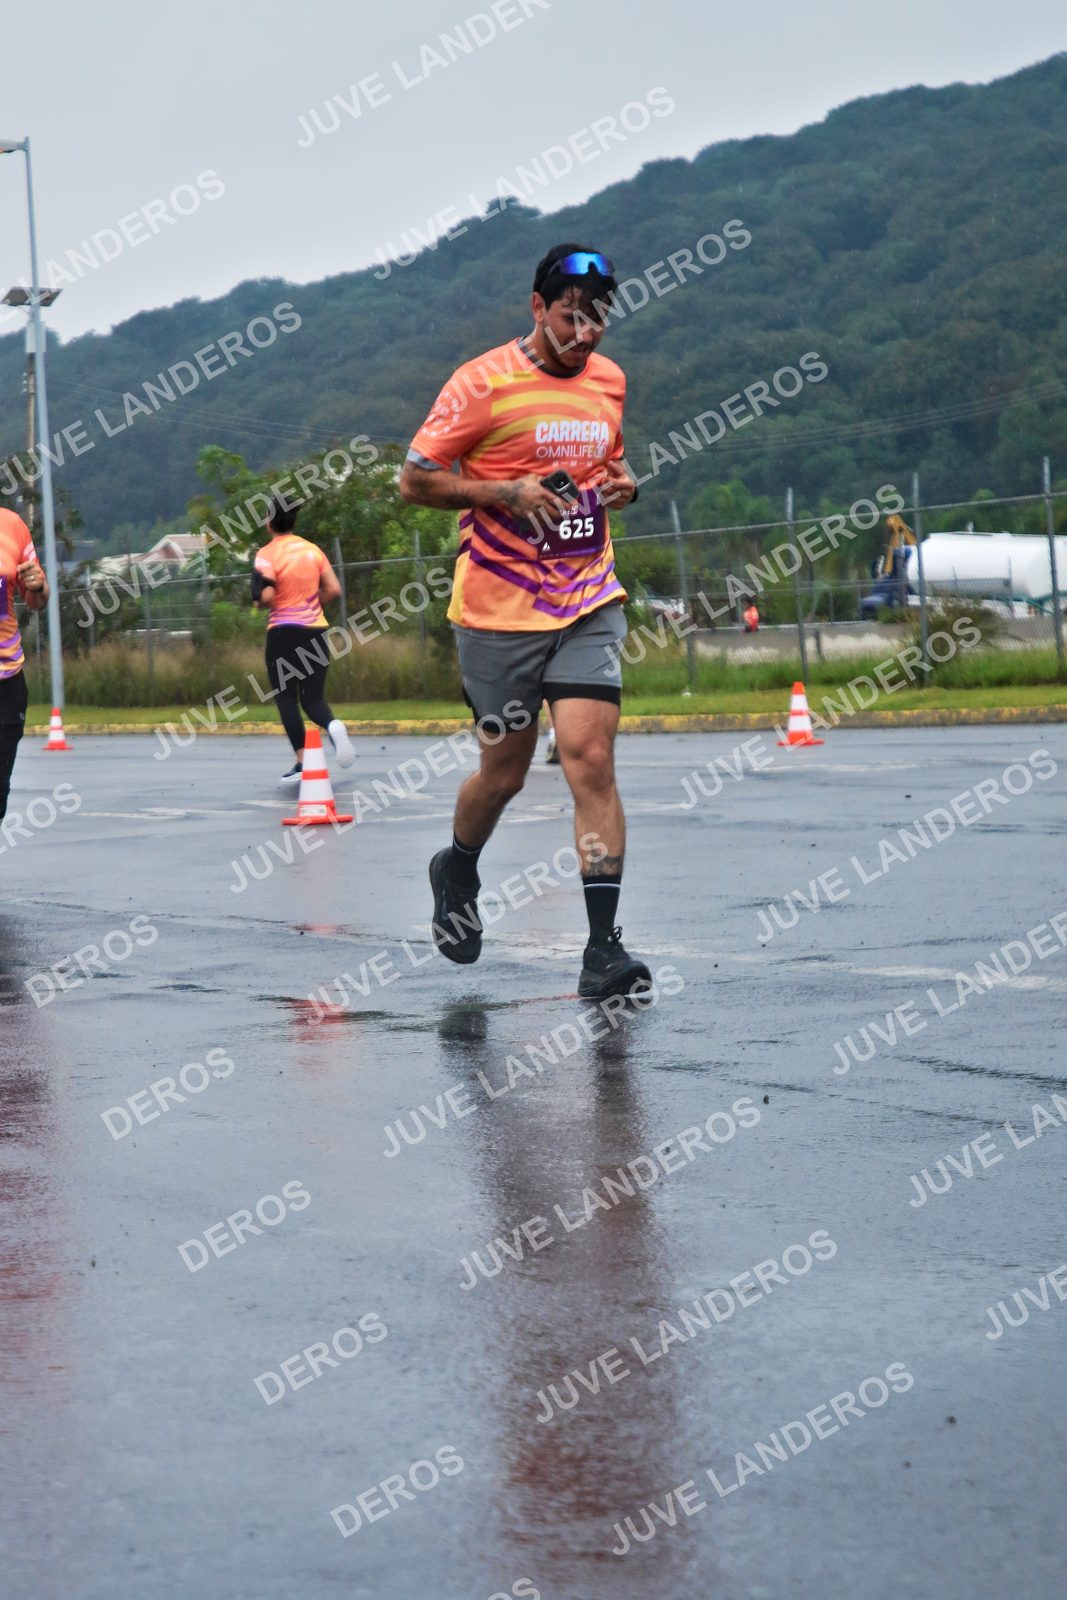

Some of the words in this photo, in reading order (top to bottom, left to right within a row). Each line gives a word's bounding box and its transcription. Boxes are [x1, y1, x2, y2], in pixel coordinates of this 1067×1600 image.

[536, 420, 608, 443] CARRERA
[536, 445, 594, 457] OMNILIFE
[559, 517, 594, 539] 625
